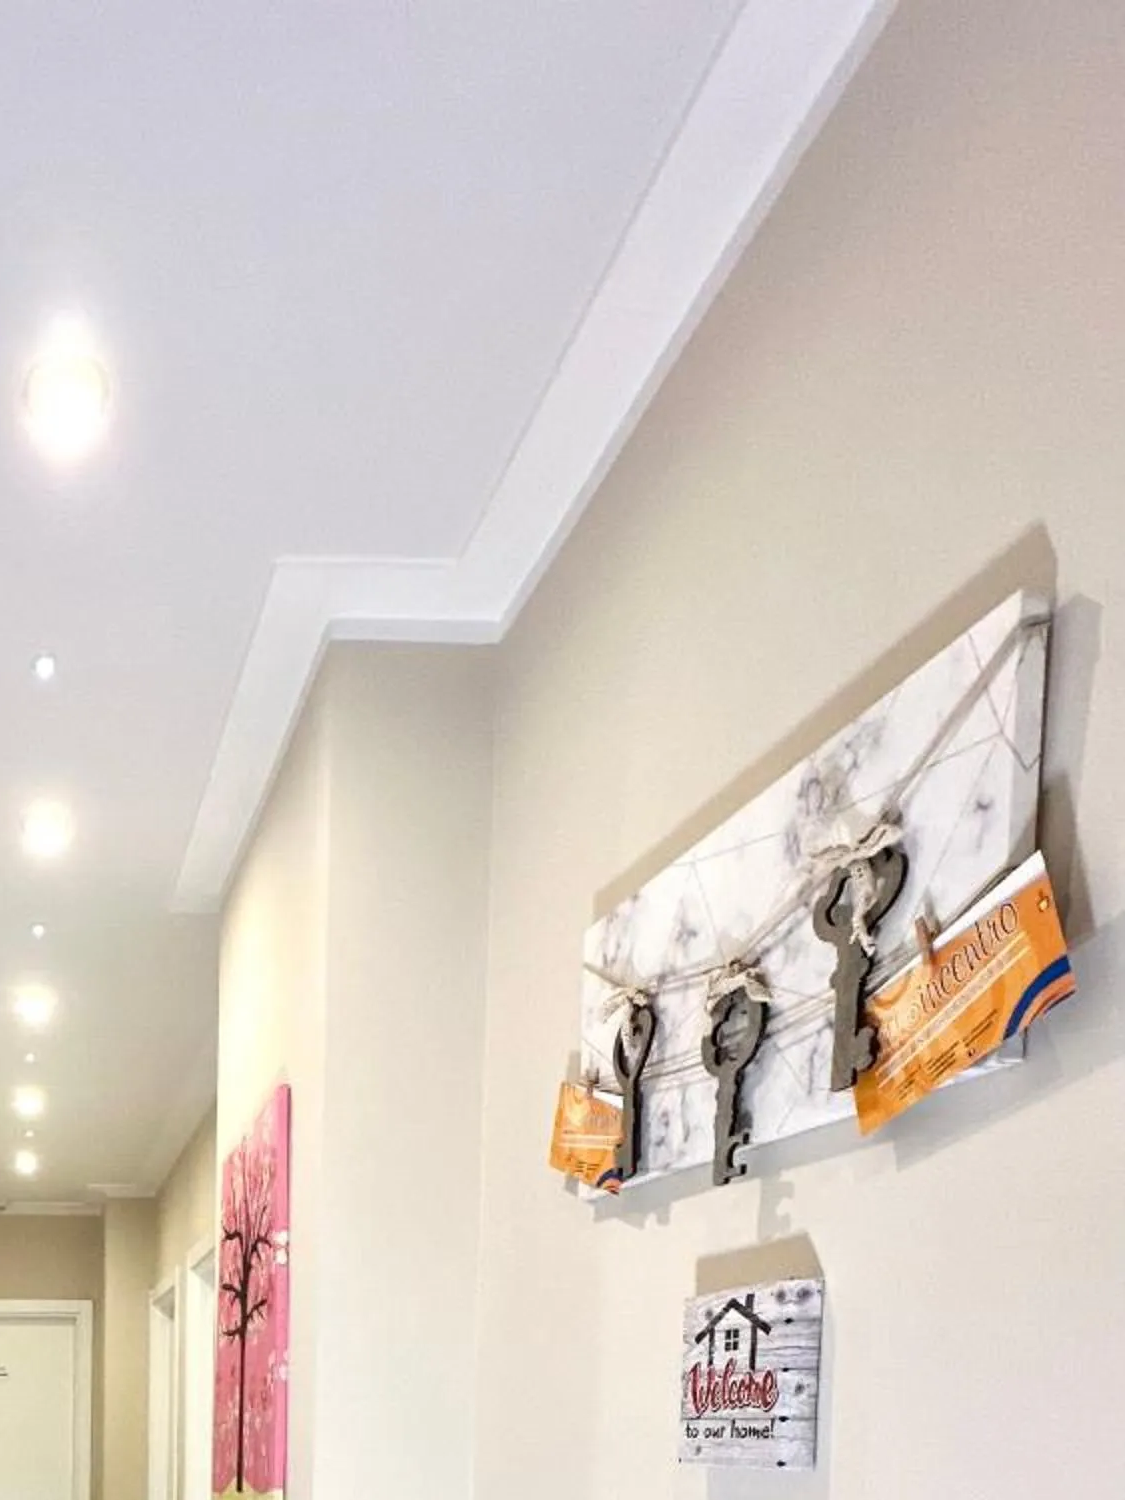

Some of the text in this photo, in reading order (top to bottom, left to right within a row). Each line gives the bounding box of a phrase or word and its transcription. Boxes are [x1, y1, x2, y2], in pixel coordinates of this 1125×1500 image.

[689, 1357, 779, 1418] Welcome
[685, 1419, 774, 1440] to our home!
